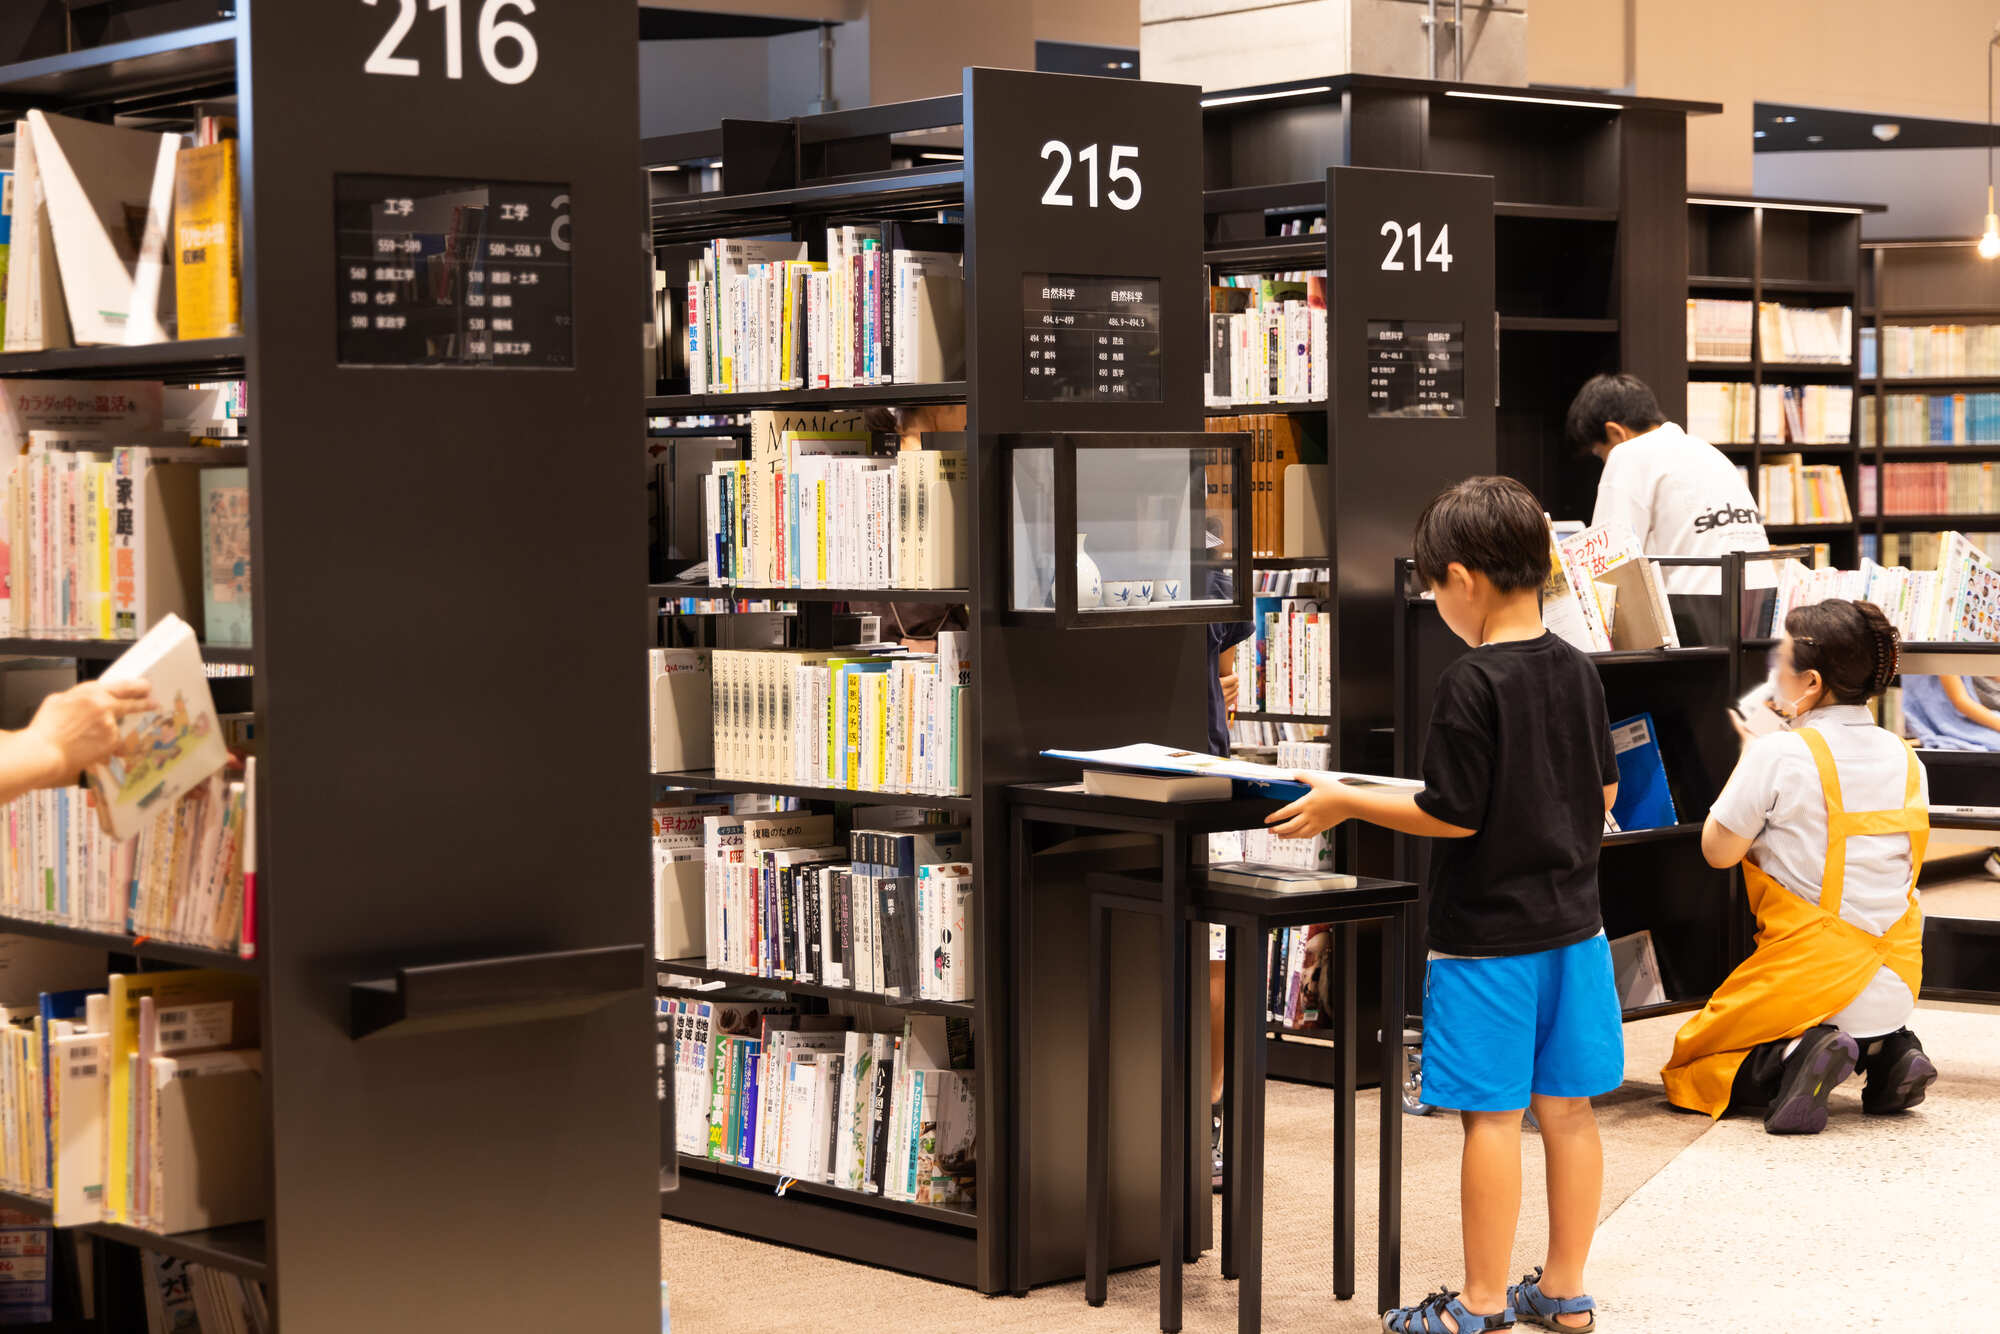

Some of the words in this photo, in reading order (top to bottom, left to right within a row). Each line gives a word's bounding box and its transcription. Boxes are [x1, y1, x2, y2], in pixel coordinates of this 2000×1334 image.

[352, 0, 539, 85] 216
[1041, 140, 1142, 210] 215
[384, 199, 414, 216] 工学
[501, 204, 529, 221] 工学
[1380, 220, 1453, 272] 214
[1042, 288, 1076, 300] 自然科学
[1111, 291, 1143, 302] 自然科学
[874, 1066, 887, 1122] ハーブ図鑑
